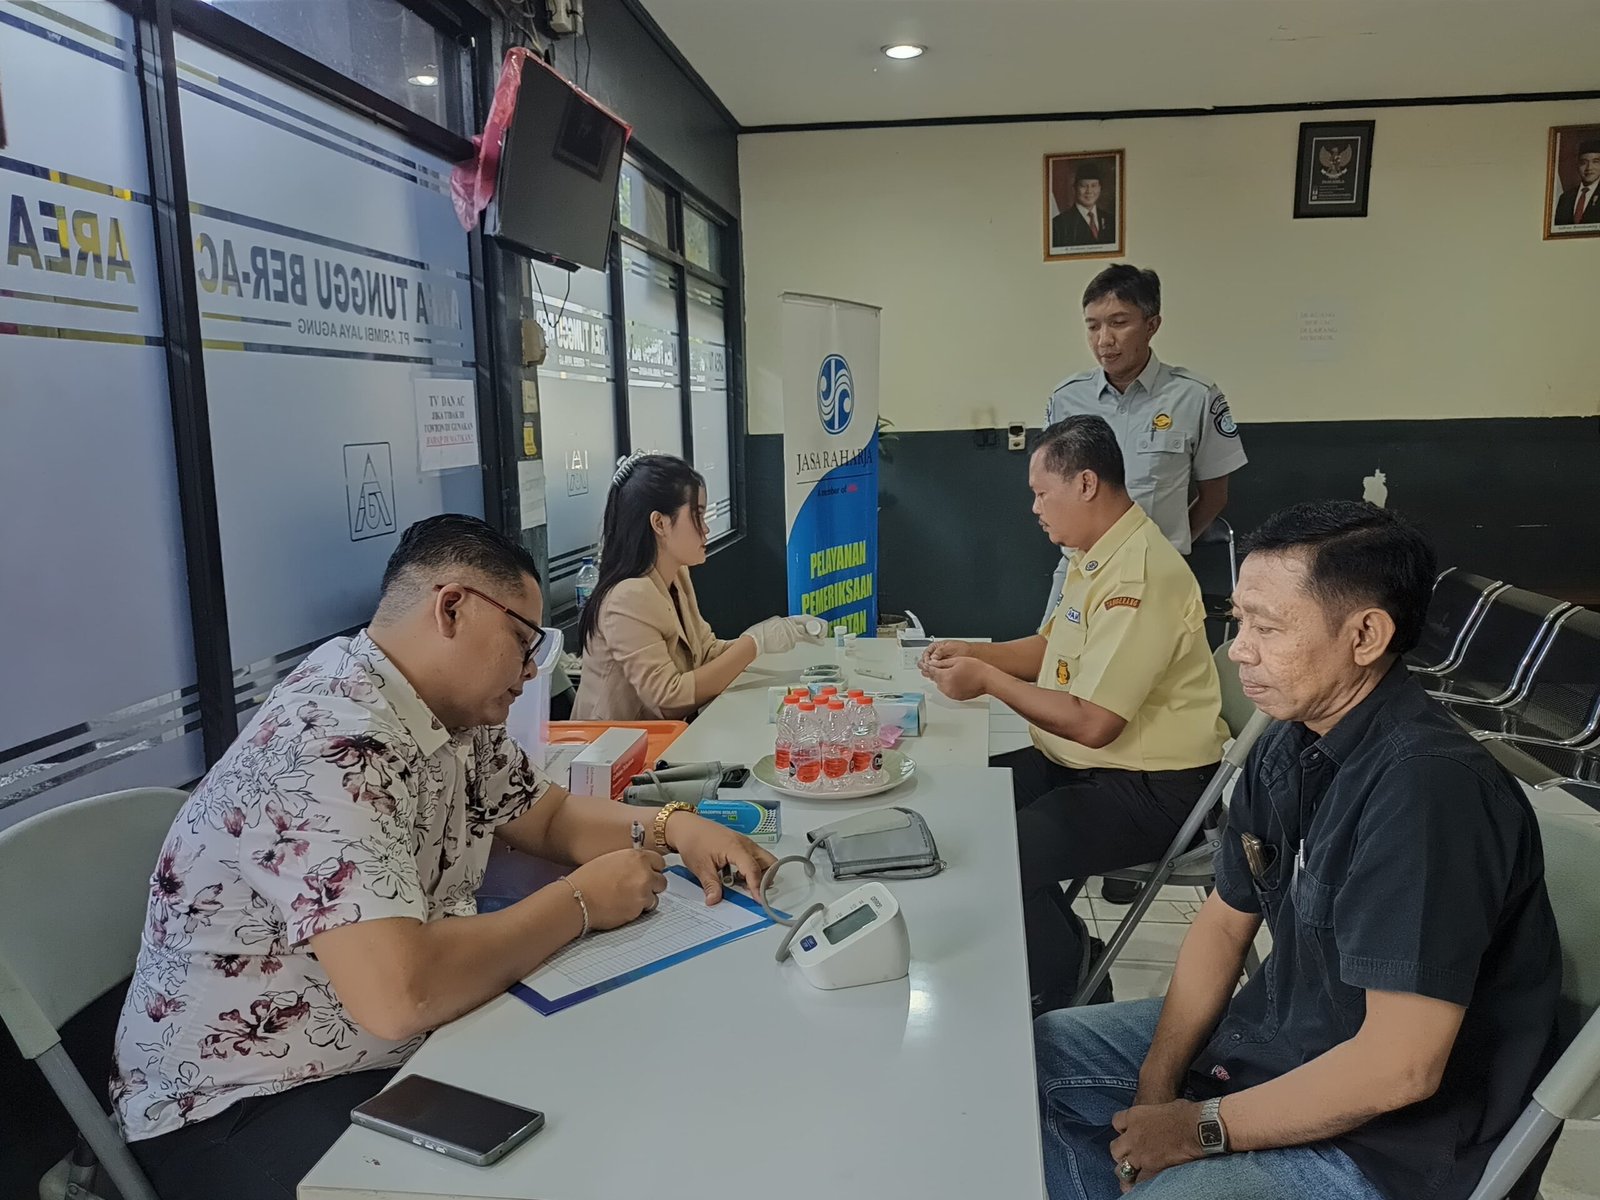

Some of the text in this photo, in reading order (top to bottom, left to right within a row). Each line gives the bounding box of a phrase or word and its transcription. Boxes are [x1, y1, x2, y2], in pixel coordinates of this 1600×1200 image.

[429, 395, 439, 407] TV
[796, 447, 873, 476] JASA RAHARJA
[810, 540, 866, 580] PELAYANAN
[801, 573, 873, 617] PEMERIKSAAN
